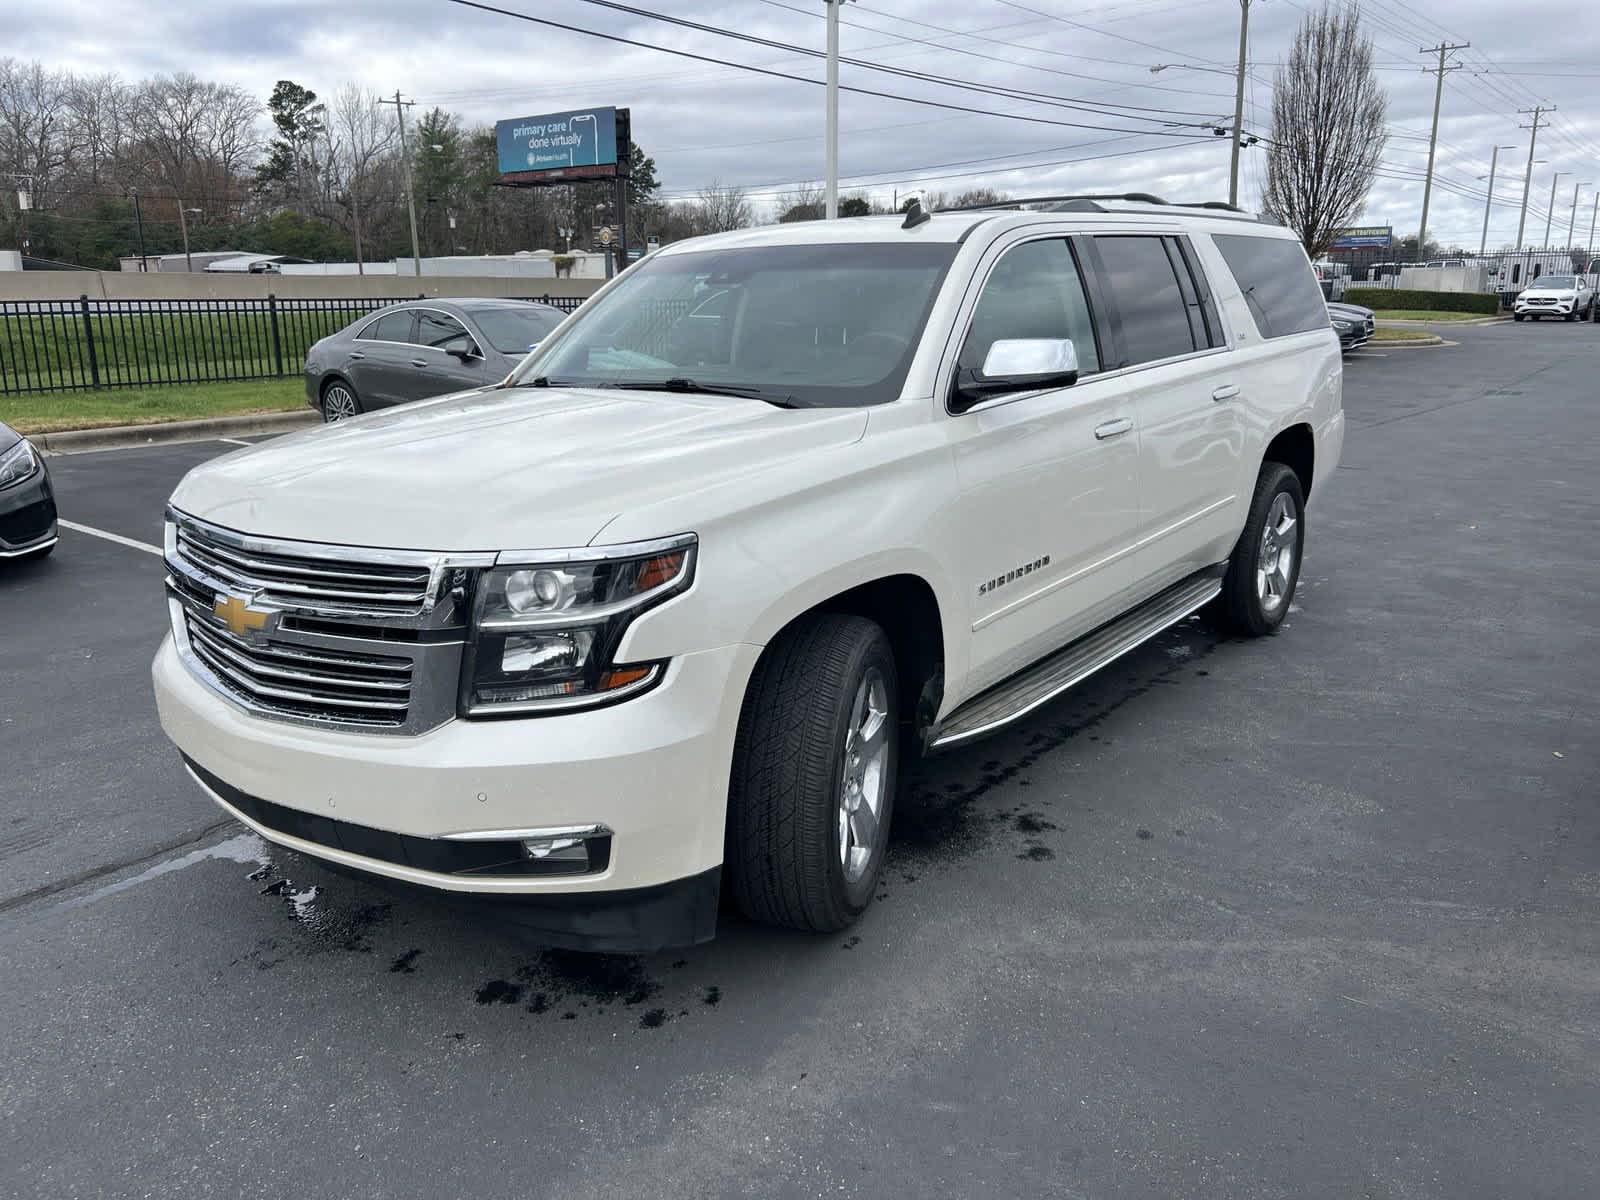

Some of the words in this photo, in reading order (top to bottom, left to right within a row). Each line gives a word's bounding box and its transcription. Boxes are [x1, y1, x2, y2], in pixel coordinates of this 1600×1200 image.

[513, 124, 546, 140] primary
[547, 122, 567, 133] care
[529, 137, 550, 149] done
[550, 132, 582, 147] virtually
[977, 554, 1050, 596] SUBURBAN
